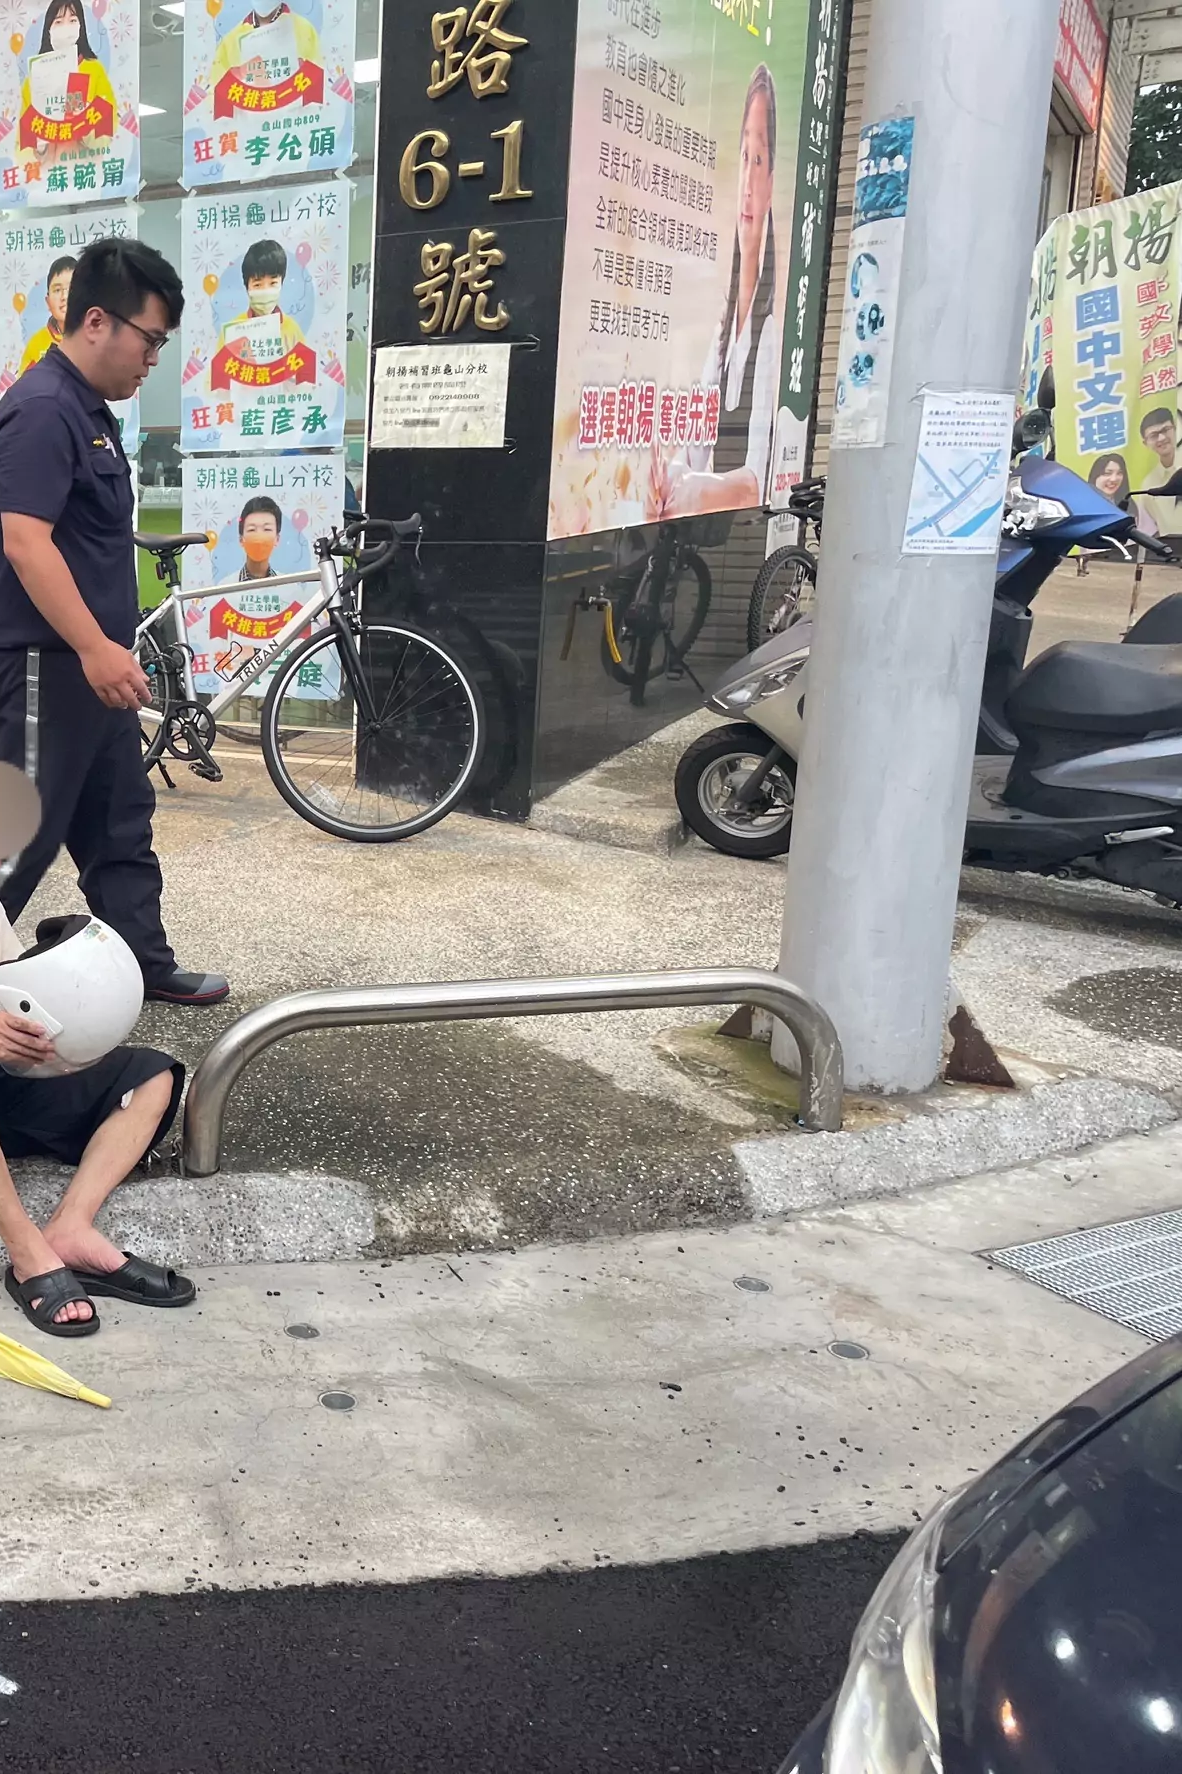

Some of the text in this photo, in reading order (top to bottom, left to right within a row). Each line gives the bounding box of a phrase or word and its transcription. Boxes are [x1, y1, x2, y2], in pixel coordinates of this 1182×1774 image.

[227, 71, 313, 110] 校排第一名
[604, 33, 687, 107] 教育也會隨之進化
[31, 106, 103, 140] 校排第一名
[601, 86, 718, 171] 國中是身心發展的重要時期
[193, 125, 337, 167] 狂賀 李允碩
[2, 161, 42, 190] 狂賀
[195, 191, 338, 231] 朝揚龜山分校
[595, 195, 719, 262] 全新的綜合領域環境即將來臨
[1066, 200, 1178, 286] 朝揚
[592, 247, 674, 296] 不單是要懂得預習
[589, 299, 670, 342] 更要找對思考方向
[224, 352, 305, 385] 校排第一名
[384, 362, 488, 378] 朝揚補習班龜山分校
[1075, 284, 1127, 453] 國中文理
[1139, 367, 1178, 399] 自然
[191, 402, 235, 430] 狂賀
[579, 383, 720, 446] 選擇朝揚 奪得先機
[196, 464, 335, 490] 朝揚龜山分校
[235, 638, 280, 684] TRIBAN
